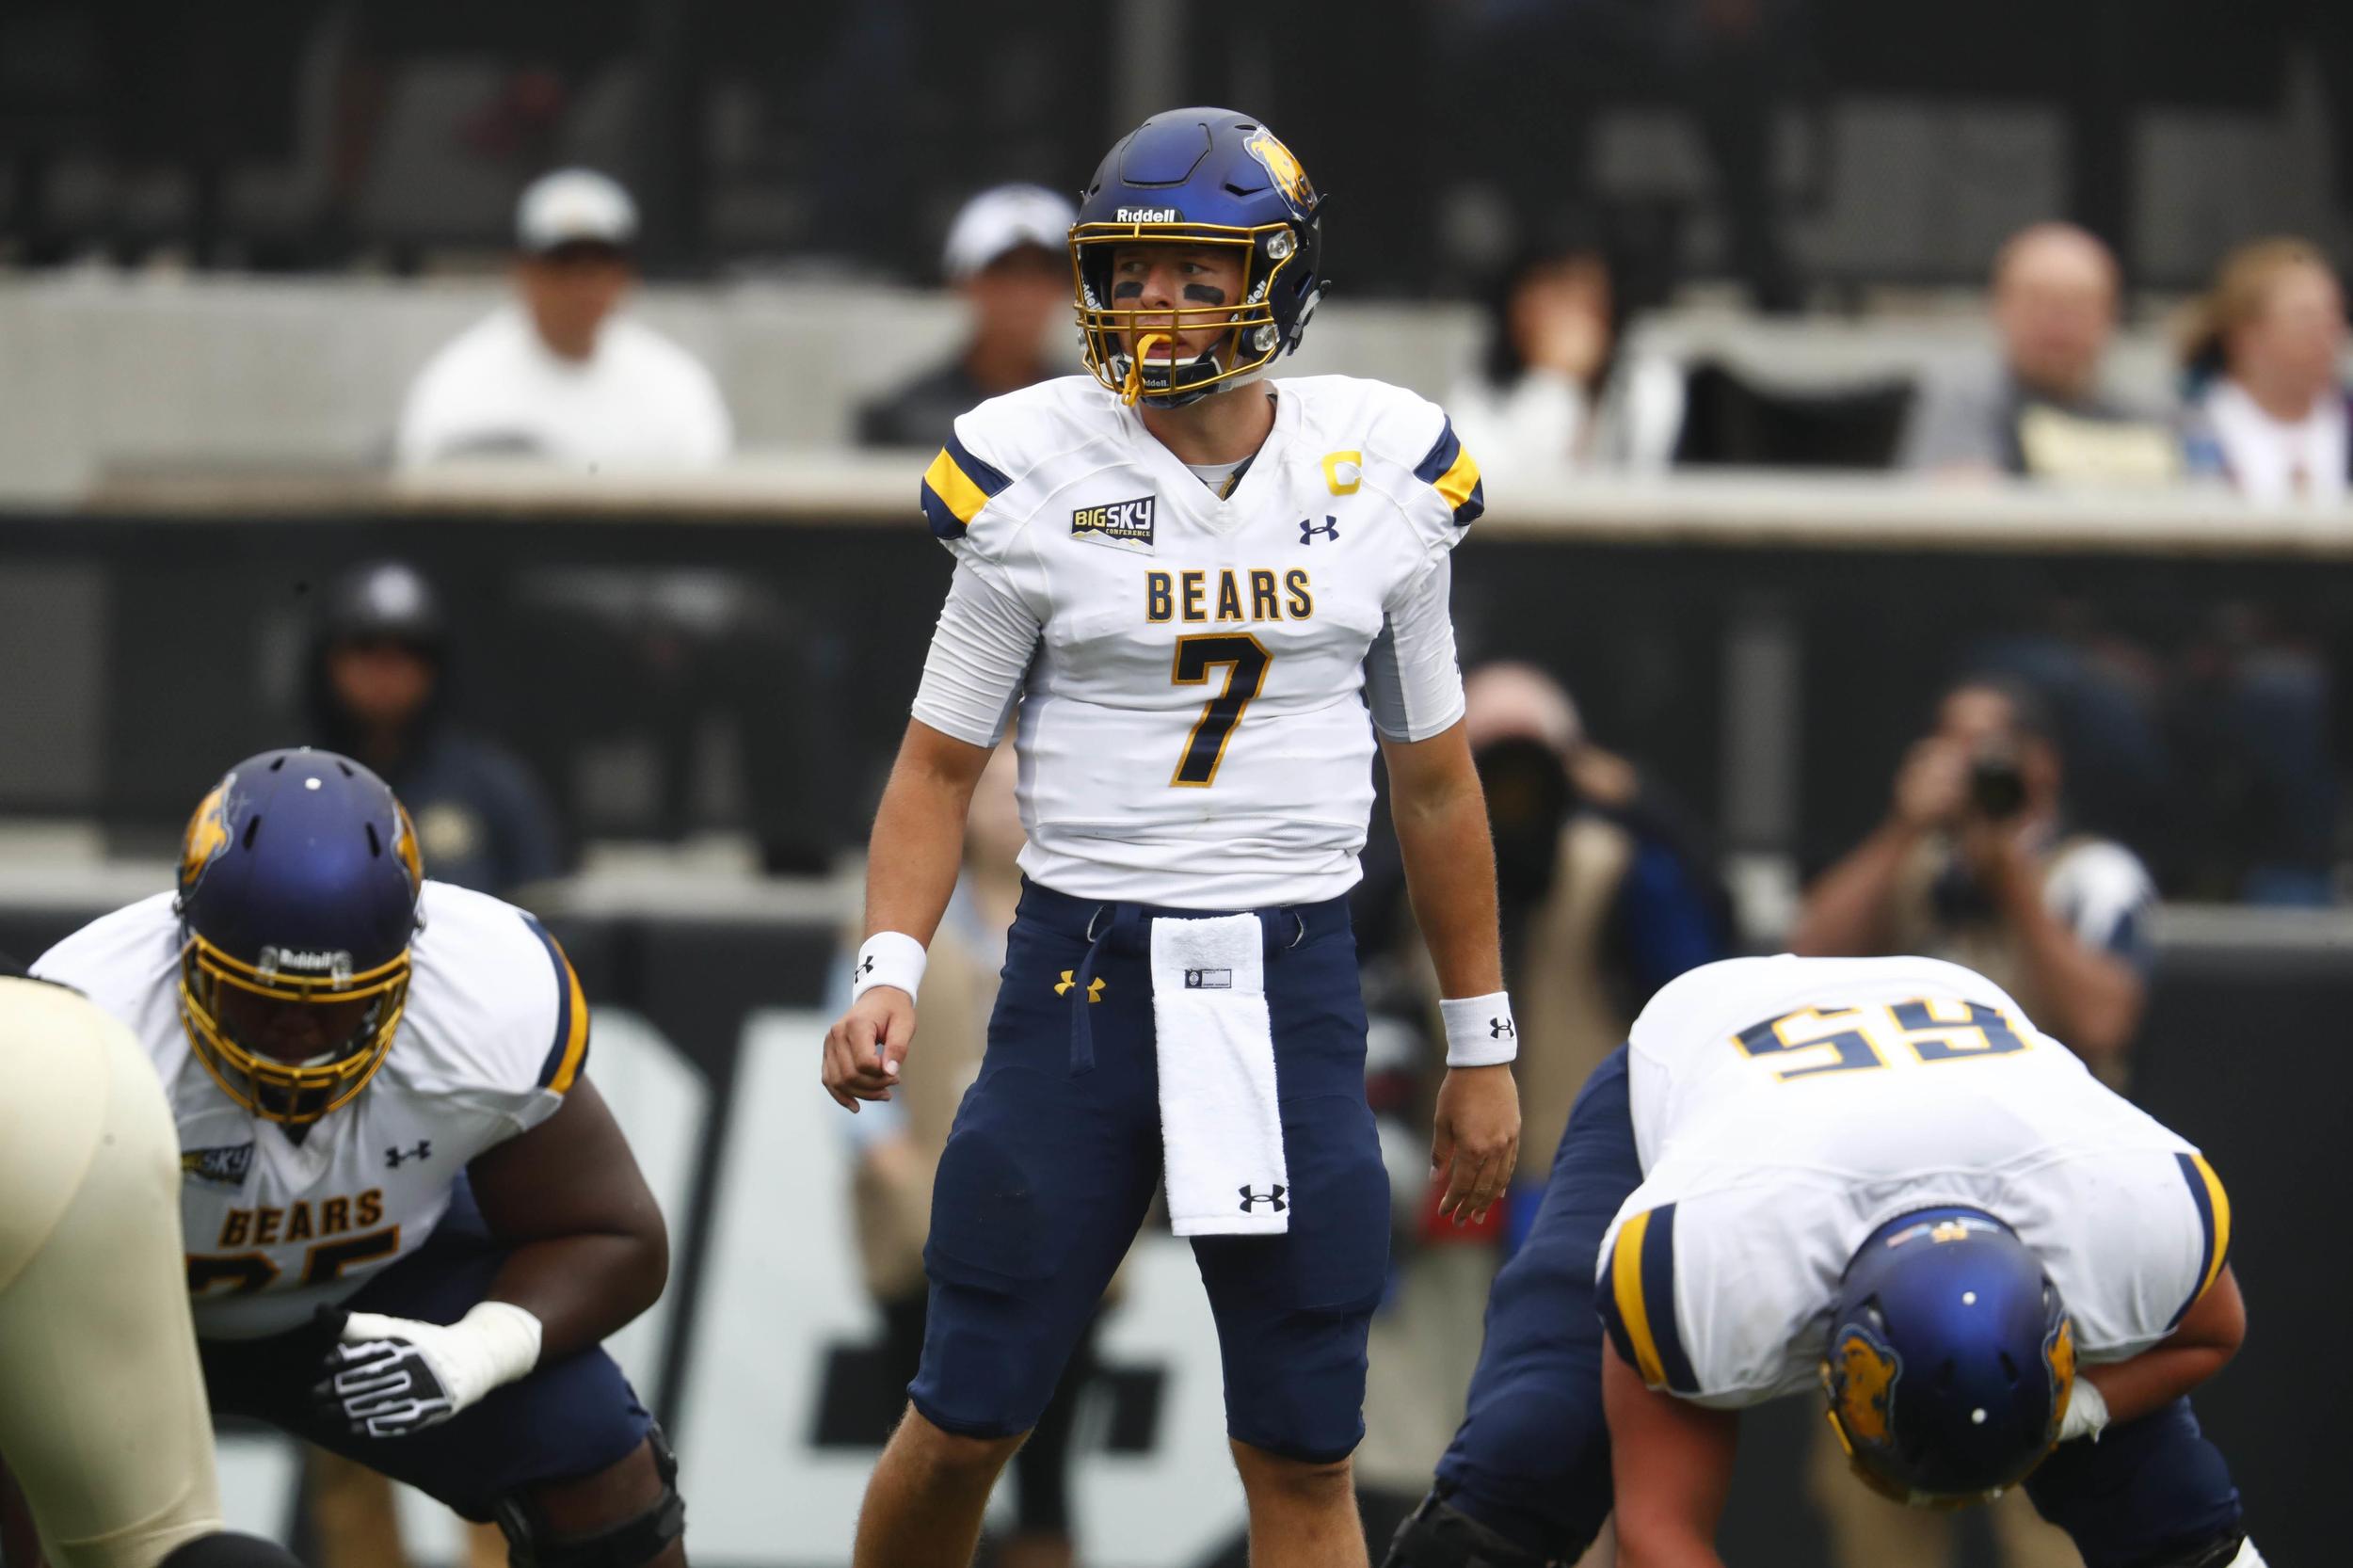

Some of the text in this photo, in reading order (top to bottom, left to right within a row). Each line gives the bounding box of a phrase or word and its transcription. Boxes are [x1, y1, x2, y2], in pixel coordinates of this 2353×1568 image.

[1117, 209, 1175, 222] Riddell
[1322, 451, 1362, 495] C
[1106, 528, 1151, 536] CONFERENCE
[1145, 568, 1313, 622] BEARS
[1170, 632, 1274, 787] 7
[218, 1188, 384, 1249] BEARS
